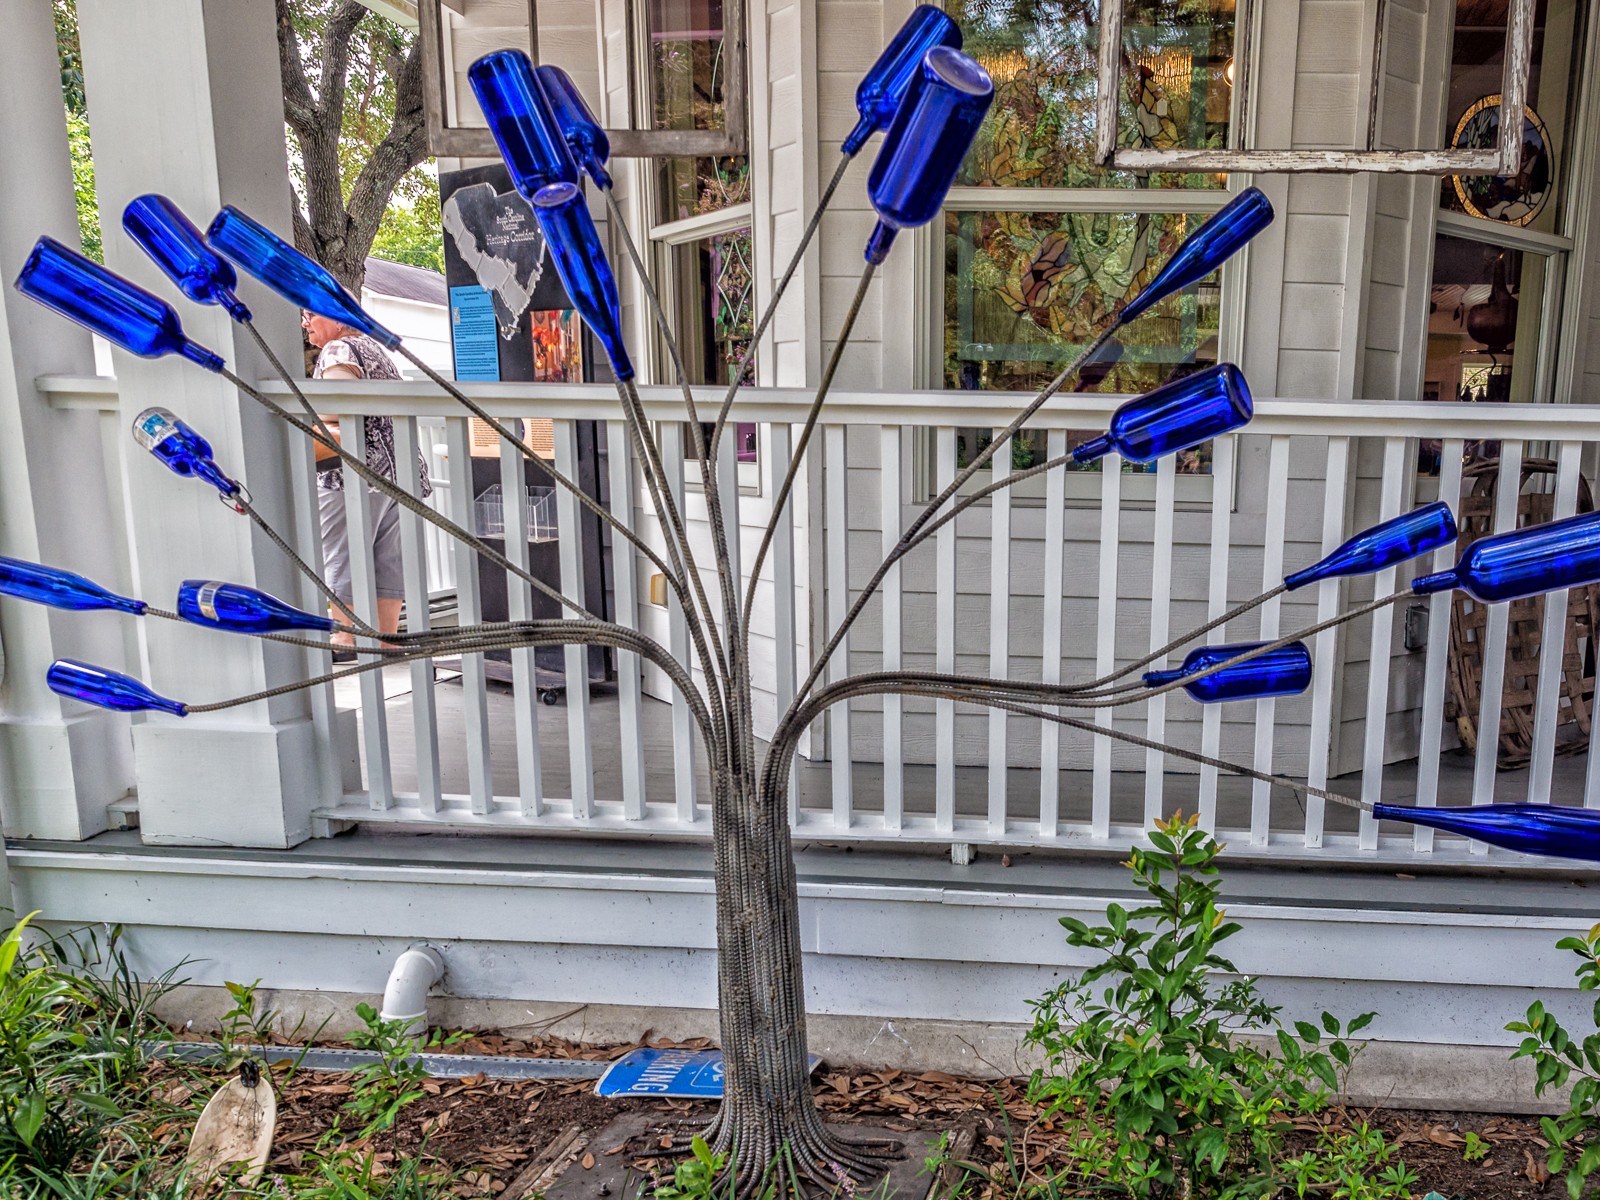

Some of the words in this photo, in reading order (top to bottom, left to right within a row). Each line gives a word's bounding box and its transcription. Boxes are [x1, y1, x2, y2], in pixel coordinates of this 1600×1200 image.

[504, 206, 514, 215] The
[496, 215, 508, 225] South
[508, 213, 525, 222] Carolina
[485, 234, 510, 245] Heritage
[510, 229, 535, 242] Corridor
[631, 1049, 701, 1092] PARKING
